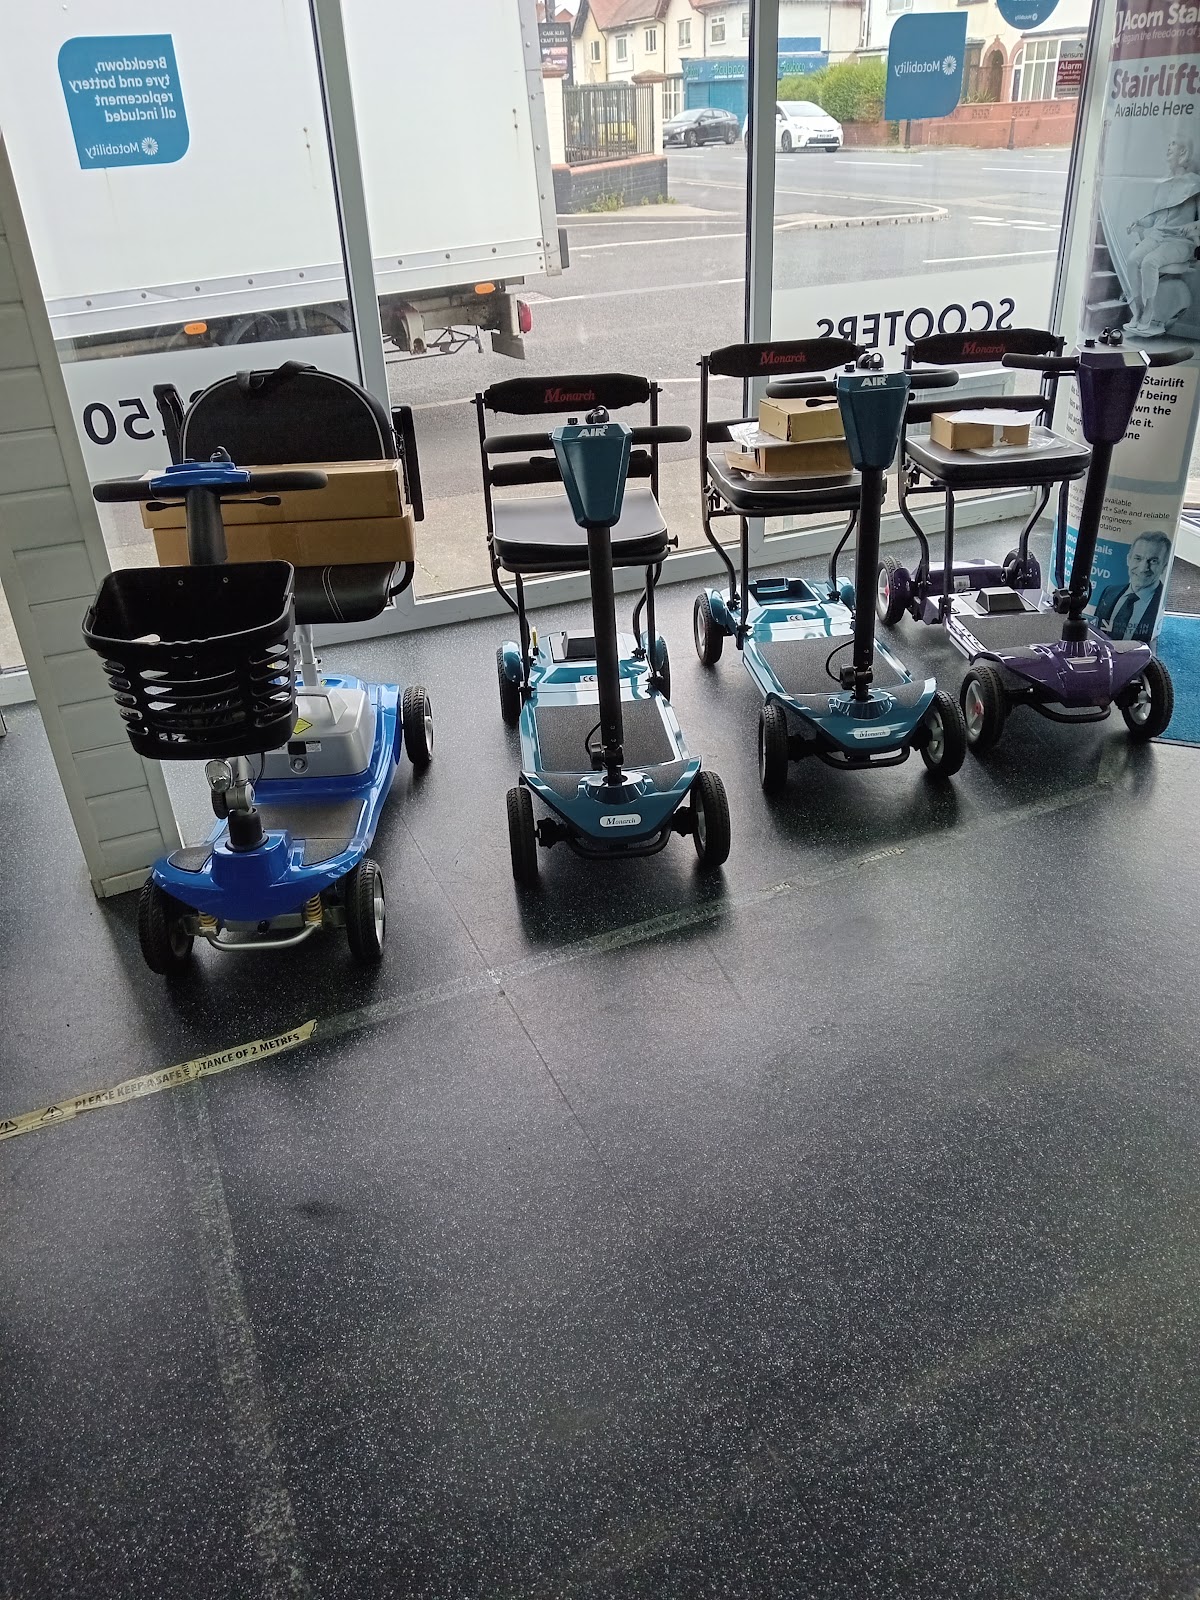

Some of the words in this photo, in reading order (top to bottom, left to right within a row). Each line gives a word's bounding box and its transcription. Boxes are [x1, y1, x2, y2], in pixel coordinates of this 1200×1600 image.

[1122, 9, 1164, 31] Acorn
[1141, 31, 1151, 41] the
[1152, 27, 1185, 39] freedom
[1187, 25, 1197, 35] of
[1059, 61, 1083, 70] Alarm
[1114, 101, 1160, 118] Available
[1162, 101, 1195, 116] Here
[960, 341, 1006, 355] Monarch
[760, 352, 807, 366] Monarch
[861, 376, 887, 388] AIR
[1143, 375, 1185, 388] Stairlift
[543, 387, 596, 404] Monarch
[1146, 390, 1178, 403] being
[1153, 405, 1172, 416] the
[1143, 418, 1154, 428] it.
[577, 427, 606, 438] AIR
[1113, 506, 1128, 516] Safe
[1128, 510, 1143, 518] and
[1143, 511, 1171, 520] reliable
[1101, 514, 1133, 526] engineers
[1090, 566, 1111, 580] DVD
[606, 817, 636, 826] Monarch
[75, 1090, 115, 1109] PLEASE
[117, 1080, 144, 1097] KEEP
[155, 1069, 182, 1084] SAFE
[235, 1048, 249, 1059] OF
[251, 1046, 258, 1055] 2
